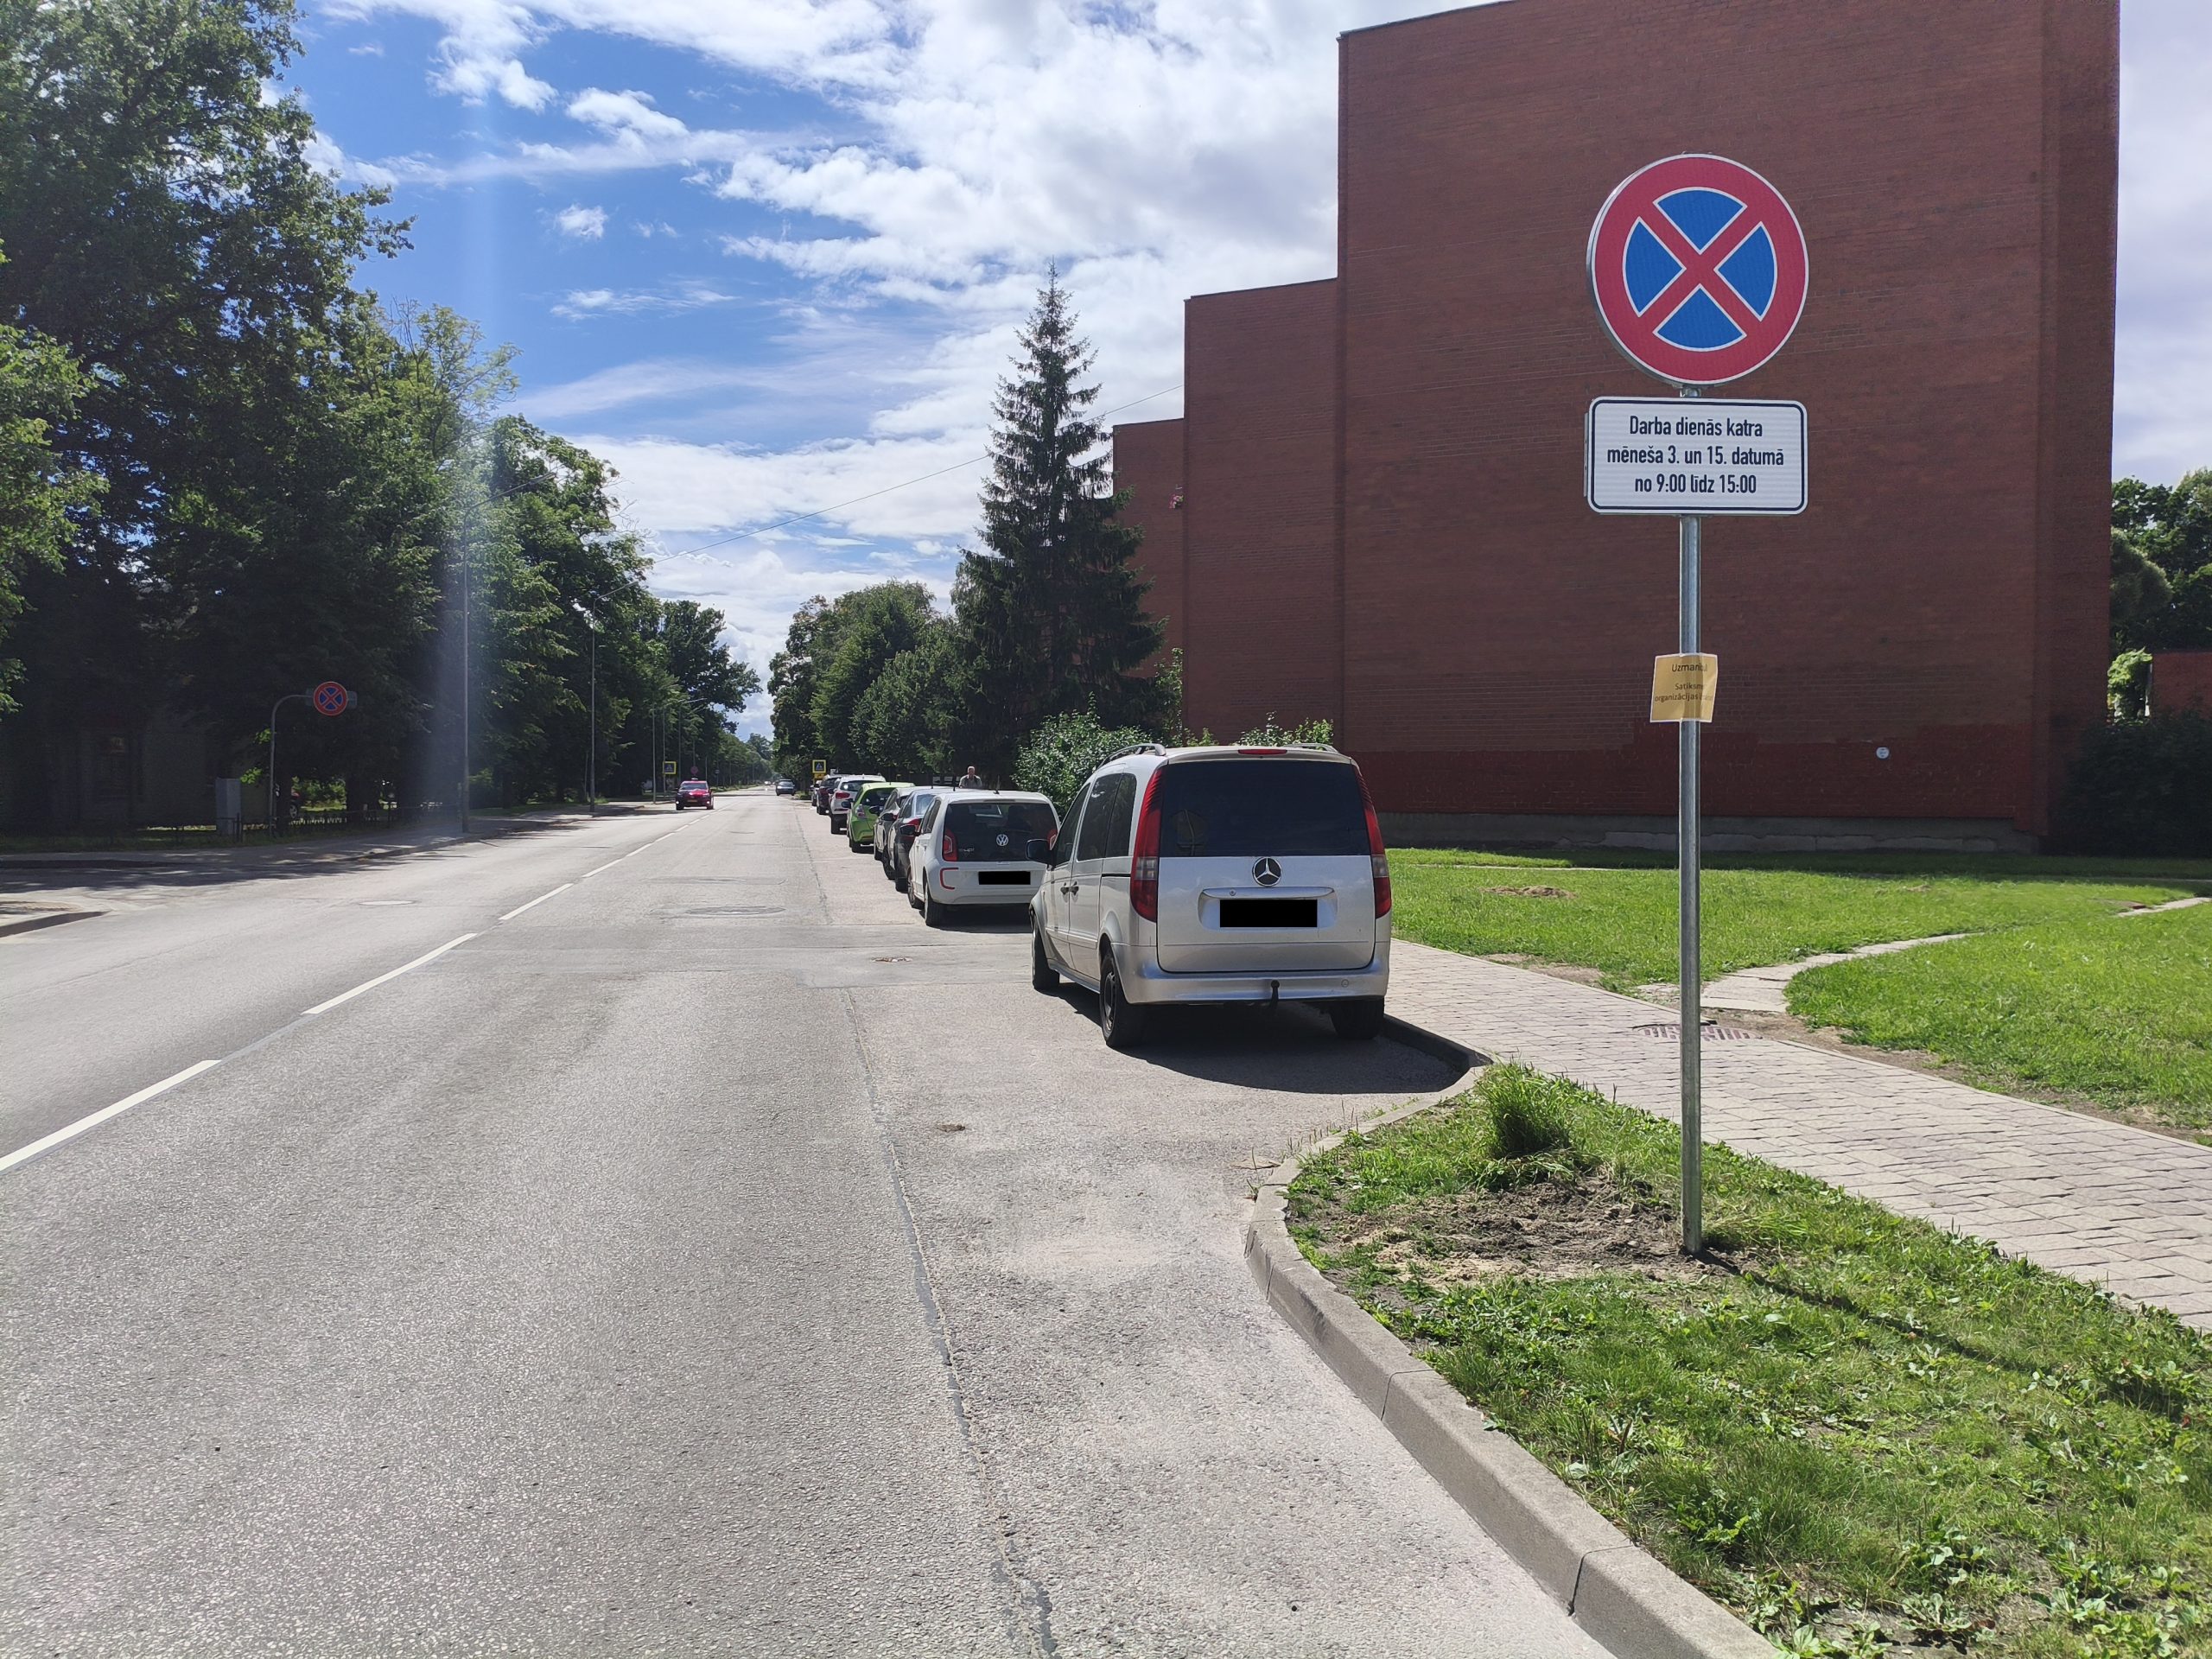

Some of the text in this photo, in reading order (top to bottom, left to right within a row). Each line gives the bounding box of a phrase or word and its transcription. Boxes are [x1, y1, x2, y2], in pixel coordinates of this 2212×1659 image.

[1630, 416, 1762, 436] Darba dienās katra
[1608, 445, 1783, 465] mēneša 3. un 15. datumā
[1636, 474, 1756, 493] no 9:00 līdz 15:00
